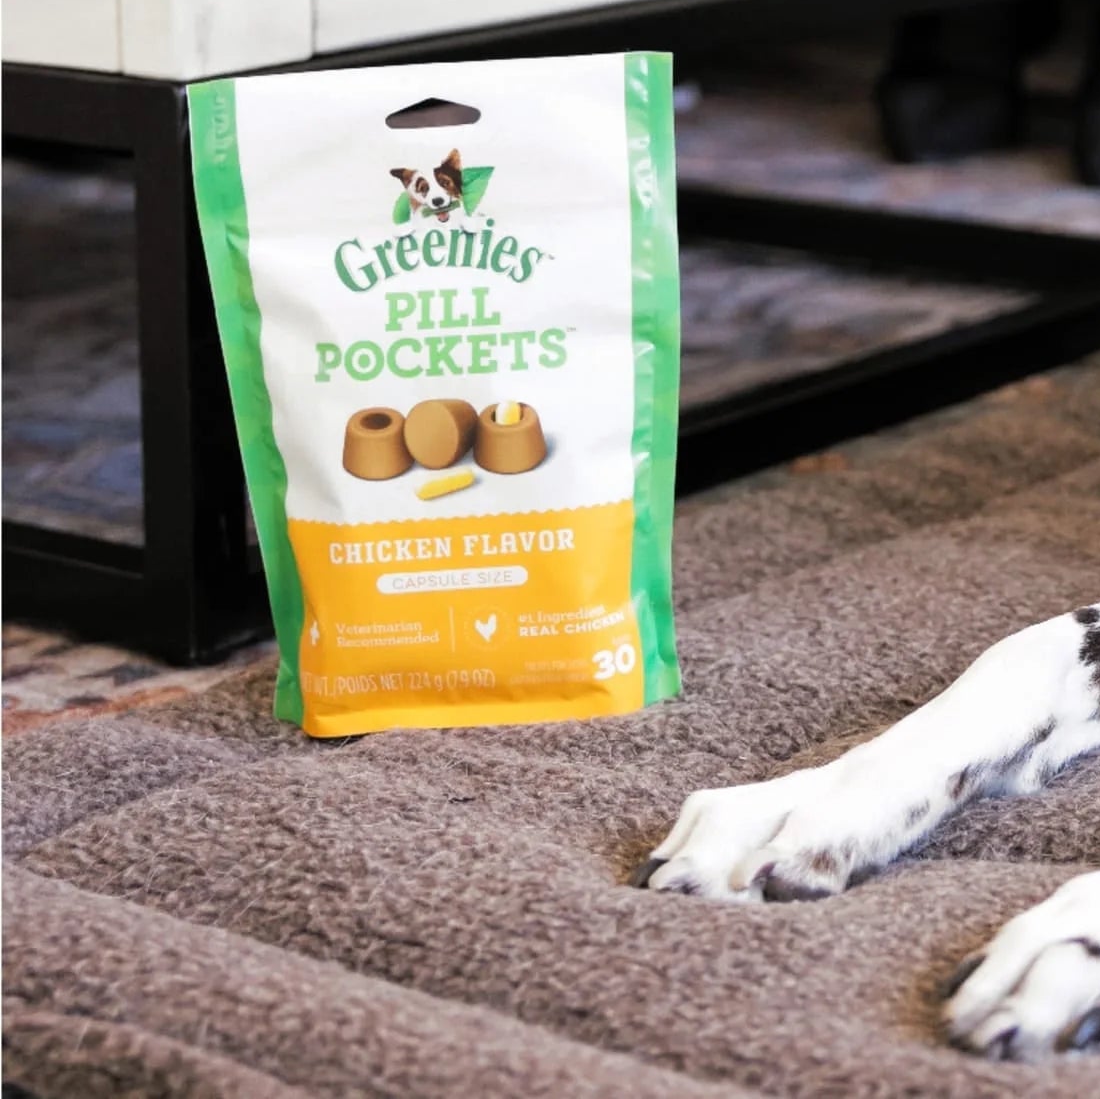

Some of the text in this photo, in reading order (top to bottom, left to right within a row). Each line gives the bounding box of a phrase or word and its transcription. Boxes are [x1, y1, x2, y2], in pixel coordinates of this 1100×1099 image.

[334, 217, 543, 292] Greenies
[384, 287, 501, 332] PILL
[314, 328, 568, 383] POCKETS
[329, 528, 575, 565] CHICKEN FLAVOR
[392, 570, 513, 590] CAPSULE SIZE
[519, 611, 625, 637] REAL CHICKEN
[592, 643, 636, 680] 30
[380, 673, 402, 693] NET
[434, 675, 443, 691] g
